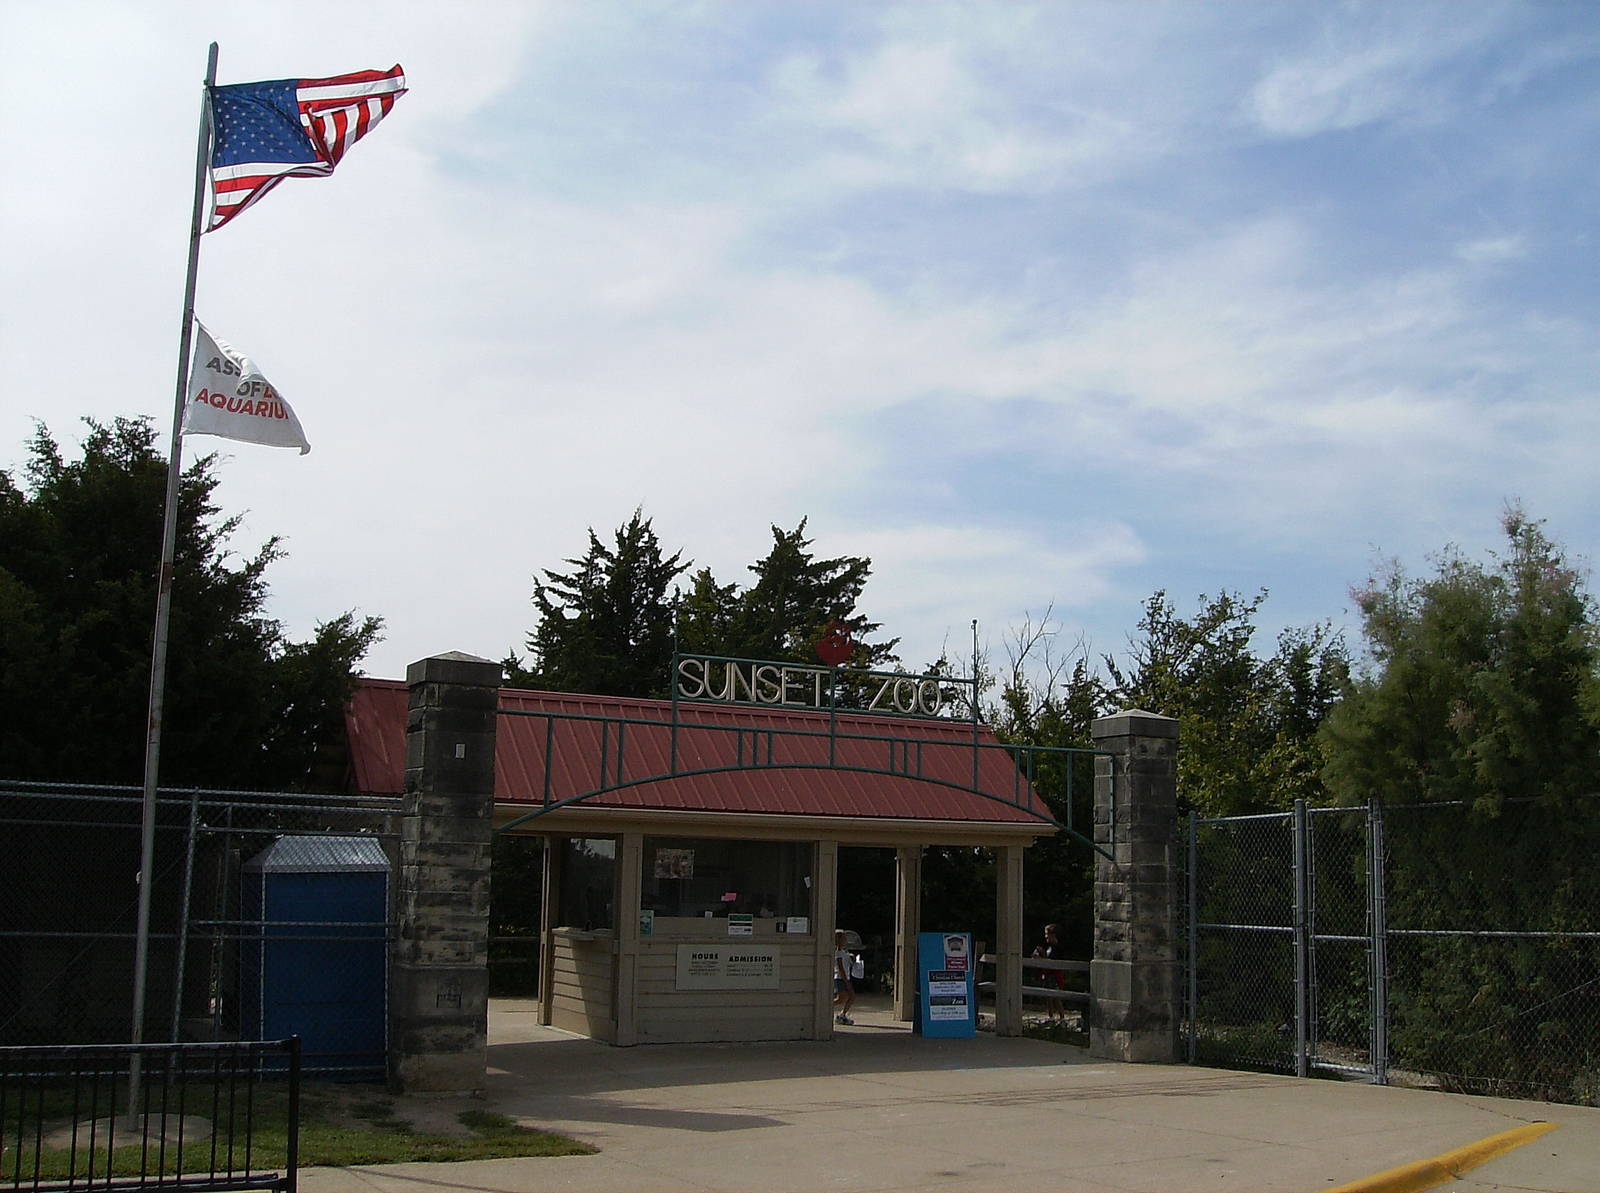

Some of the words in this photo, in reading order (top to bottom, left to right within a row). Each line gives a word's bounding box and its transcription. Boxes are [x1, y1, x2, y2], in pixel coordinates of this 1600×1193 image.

[236, 381, 261, 397] OF
[195, 388, 288, 420] AQUARIU
[678, 659, 831, 707] SUNSET
[869, 675, 942, 715] ZOO
[728, 955, 773, 963] ADMISSION
